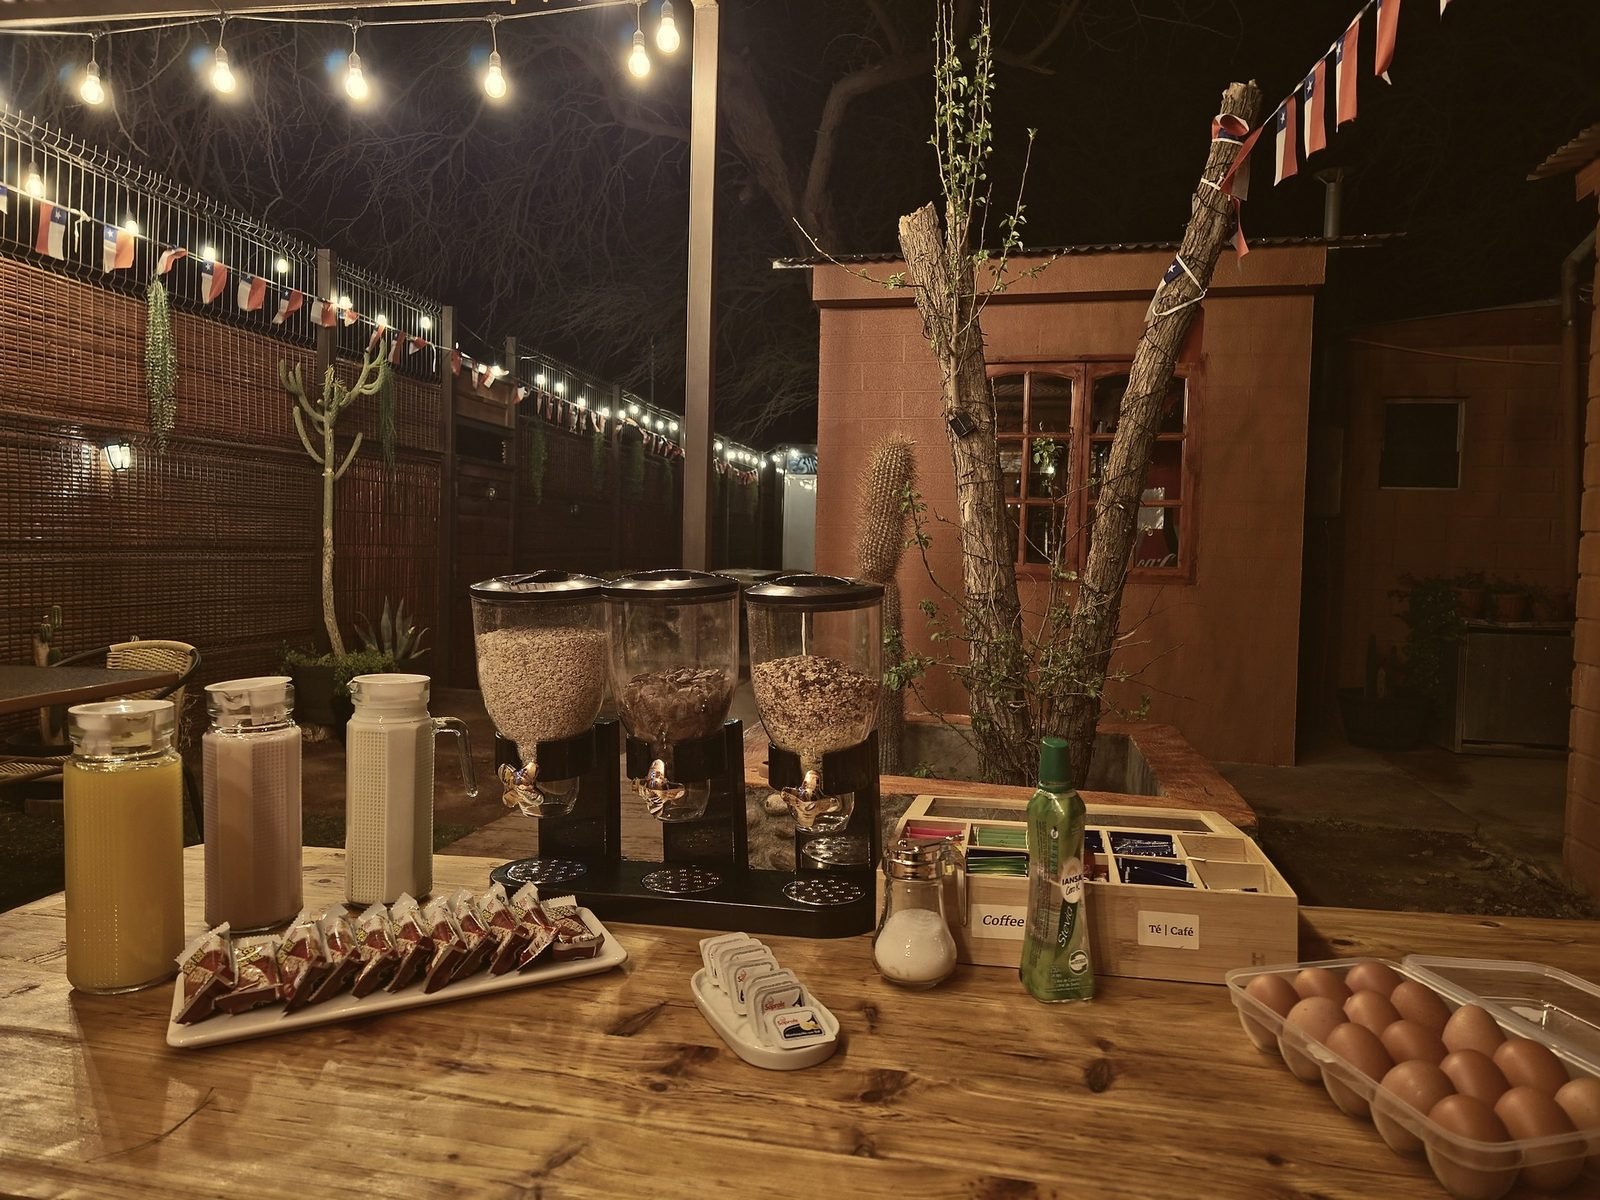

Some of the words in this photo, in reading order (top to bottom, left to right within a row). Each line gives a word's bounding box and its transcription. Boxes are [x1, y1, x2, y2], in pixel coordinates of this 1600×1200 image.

[982, 914, 1025, 927] Coffee
[1058, 905, 1073, 948] Stevia
[1148, 924, 1162, 934] Té
[1170, 926, 1194, 937] Café
